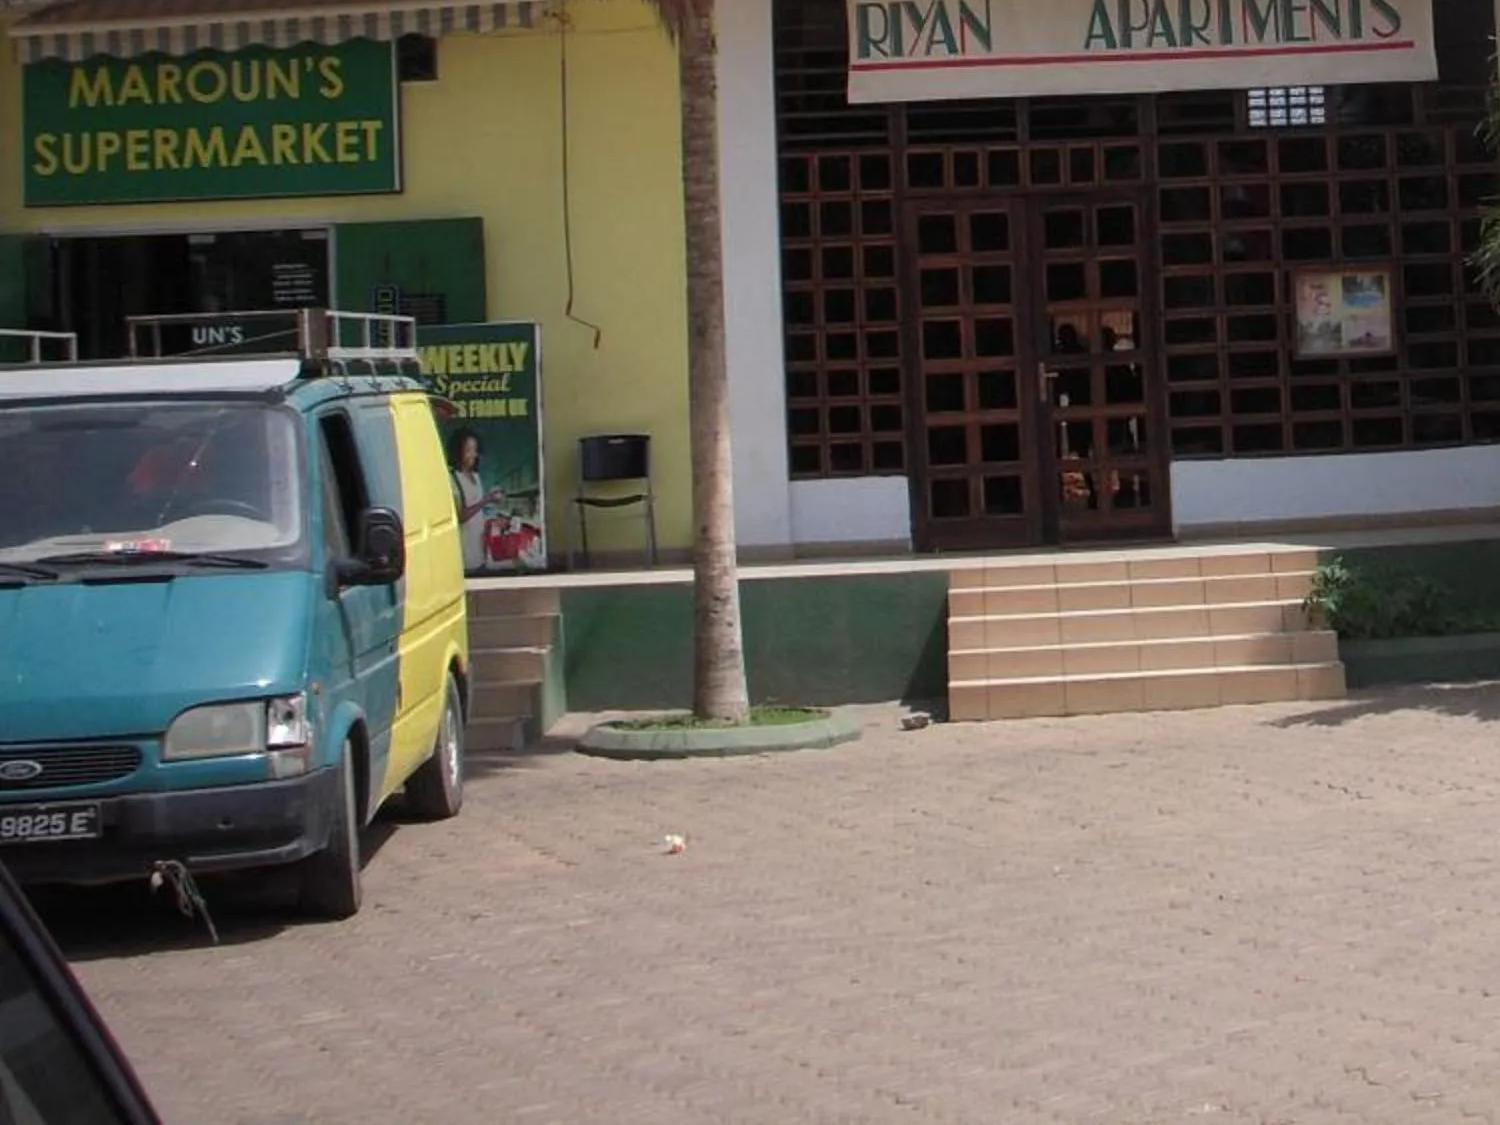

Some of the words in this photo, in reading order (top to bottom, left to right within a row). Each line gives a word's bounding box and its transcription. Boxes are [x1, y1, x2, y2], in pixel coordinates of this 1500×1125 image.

[69, 56, 344, 108] MAROUN'S
[34, 120, 384, 175] SUPERMARKET
[418, 342, 528, 374] WEEKLY
[434, 372, 511, 400] Special
